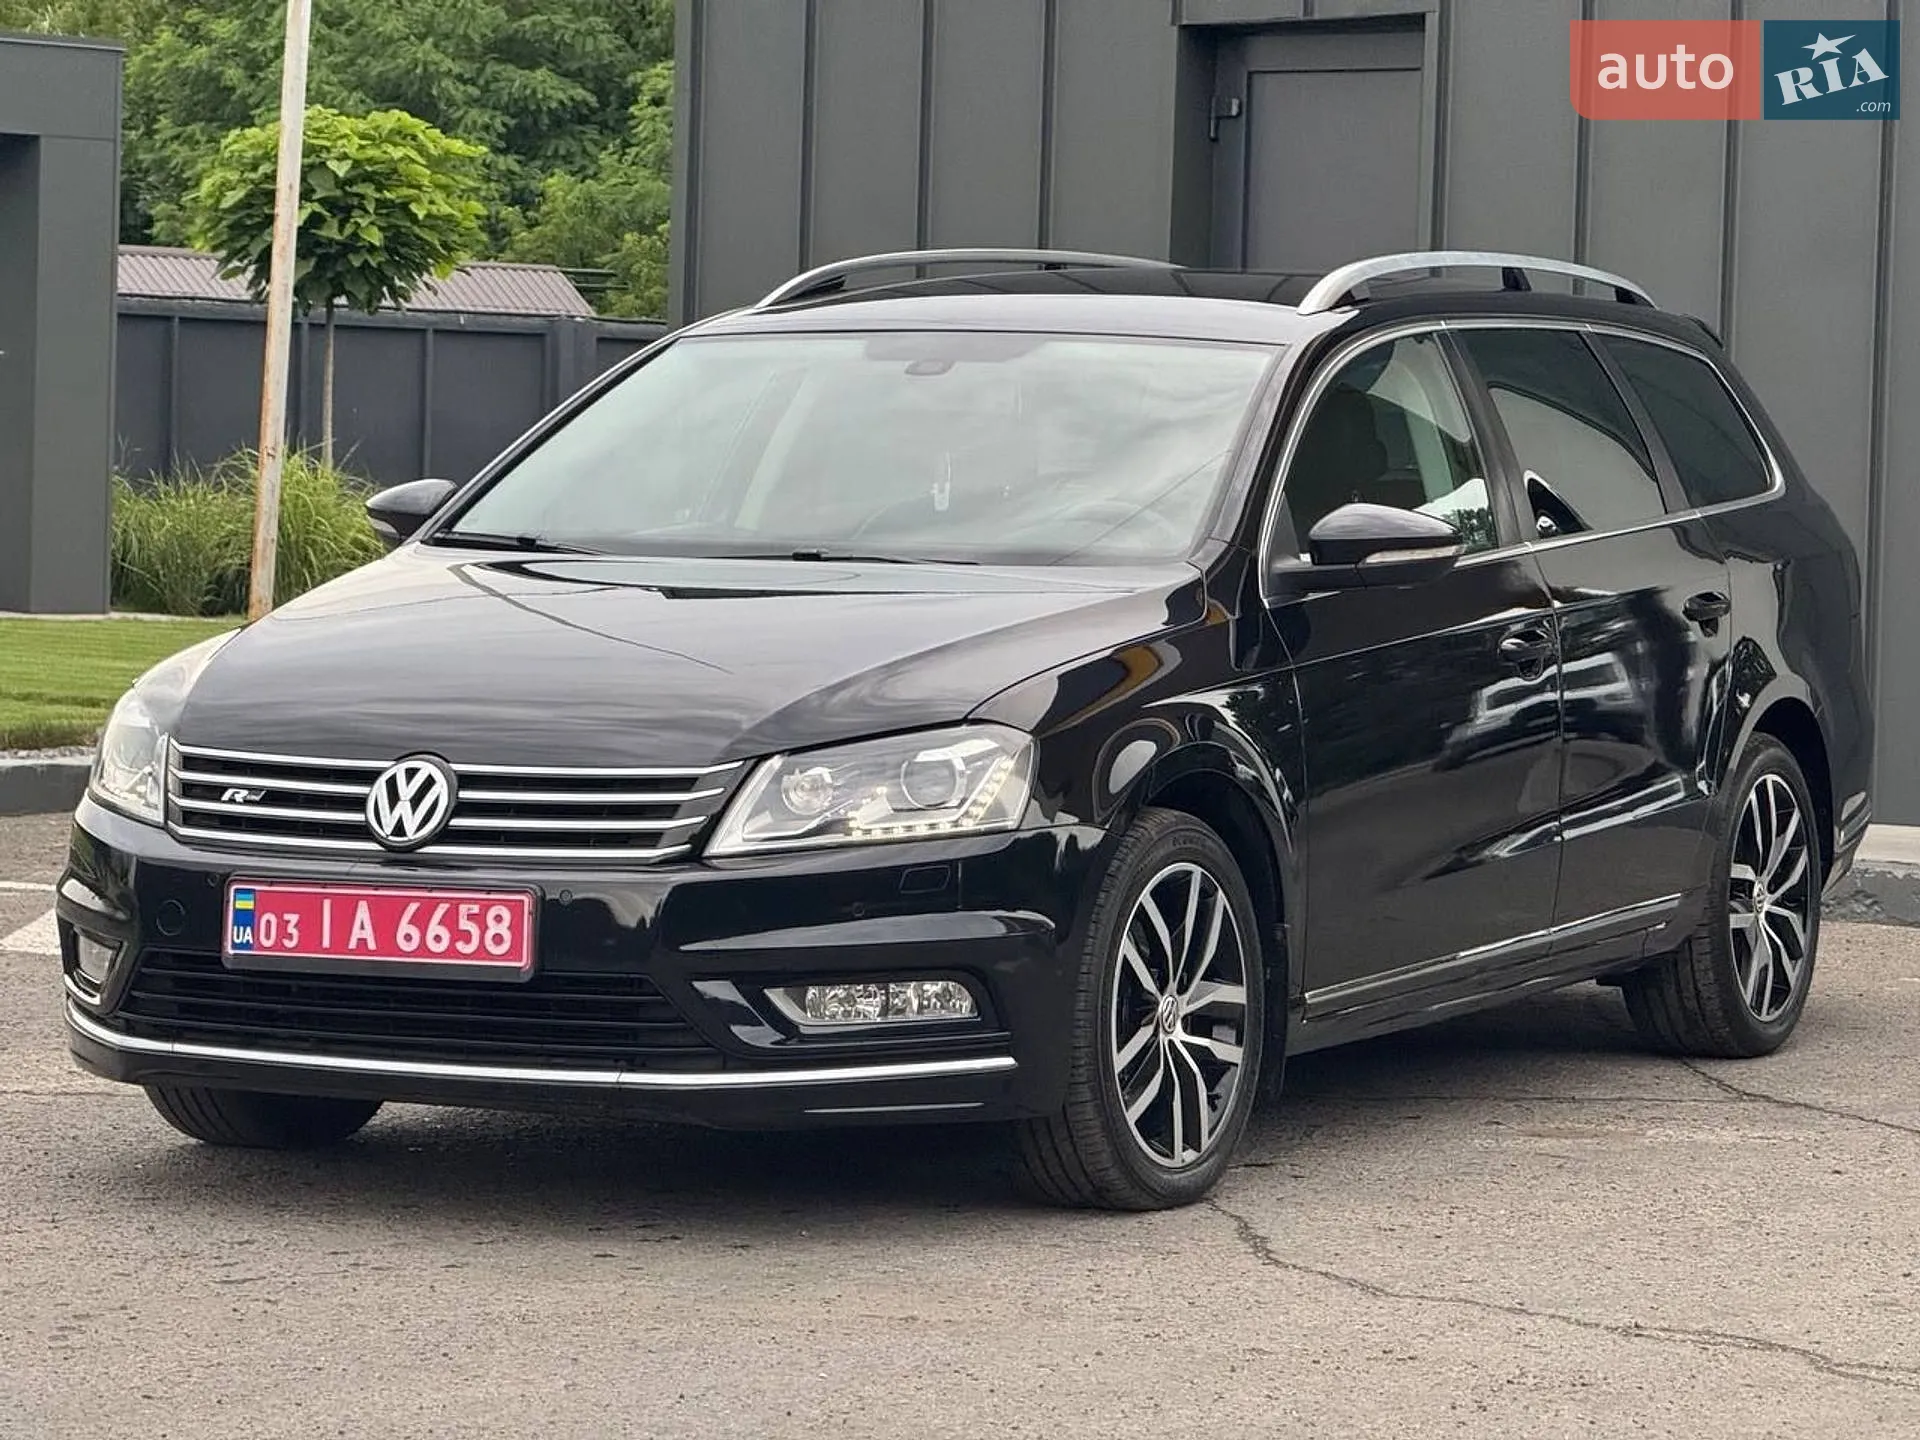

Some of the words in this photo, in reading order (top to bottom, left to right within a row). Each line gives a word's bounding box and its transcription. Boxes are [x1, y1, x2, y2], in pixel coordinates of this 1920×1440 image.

[233, 926, 253, 944] UA
[258, 912, 299, 949] 03
[396, 902, 512, 955] 6658
